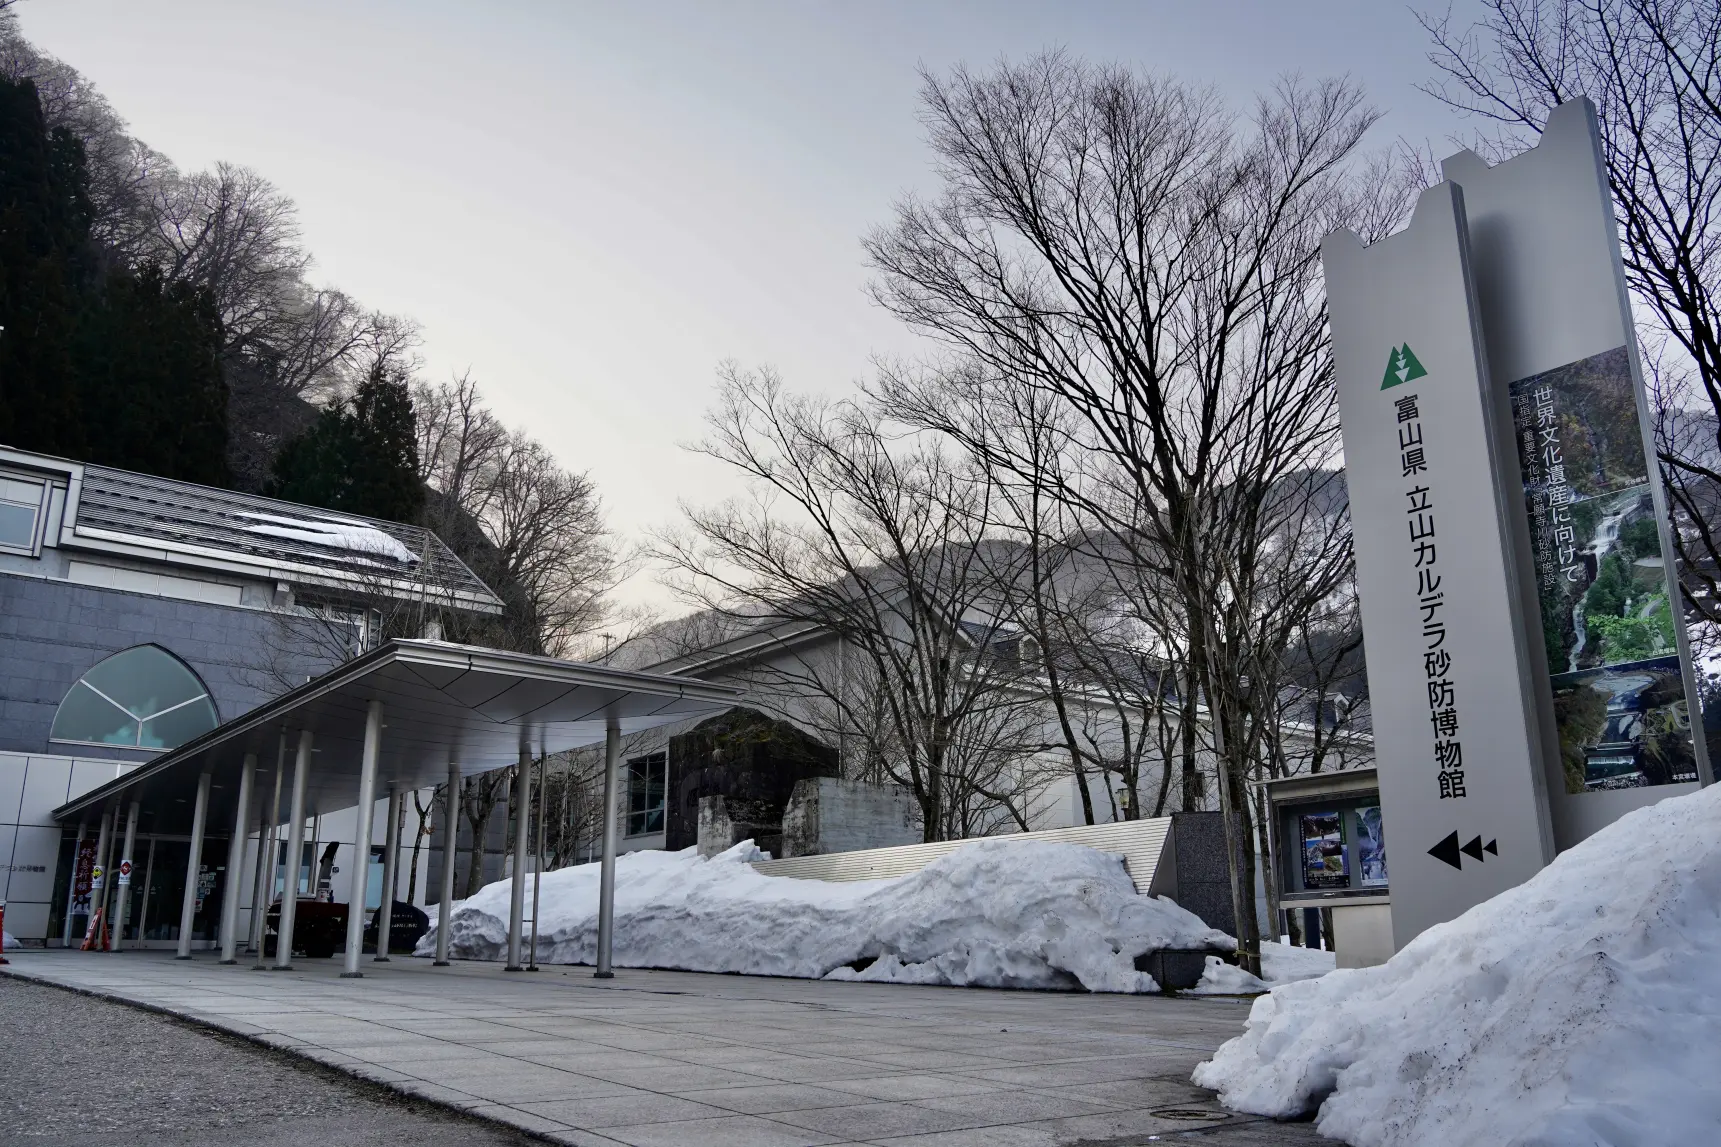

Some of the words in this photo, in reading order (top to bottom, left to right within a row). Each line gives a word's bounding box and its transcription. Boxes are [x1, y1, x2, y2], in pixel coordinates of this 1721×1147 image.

[1394, 394, 1428, 477] 富山県
[1533, 385, 1578, 582] 世界文化遺産に向けて
[1406, 485, 1467, 799] 立山カルデラ砂防博物館
